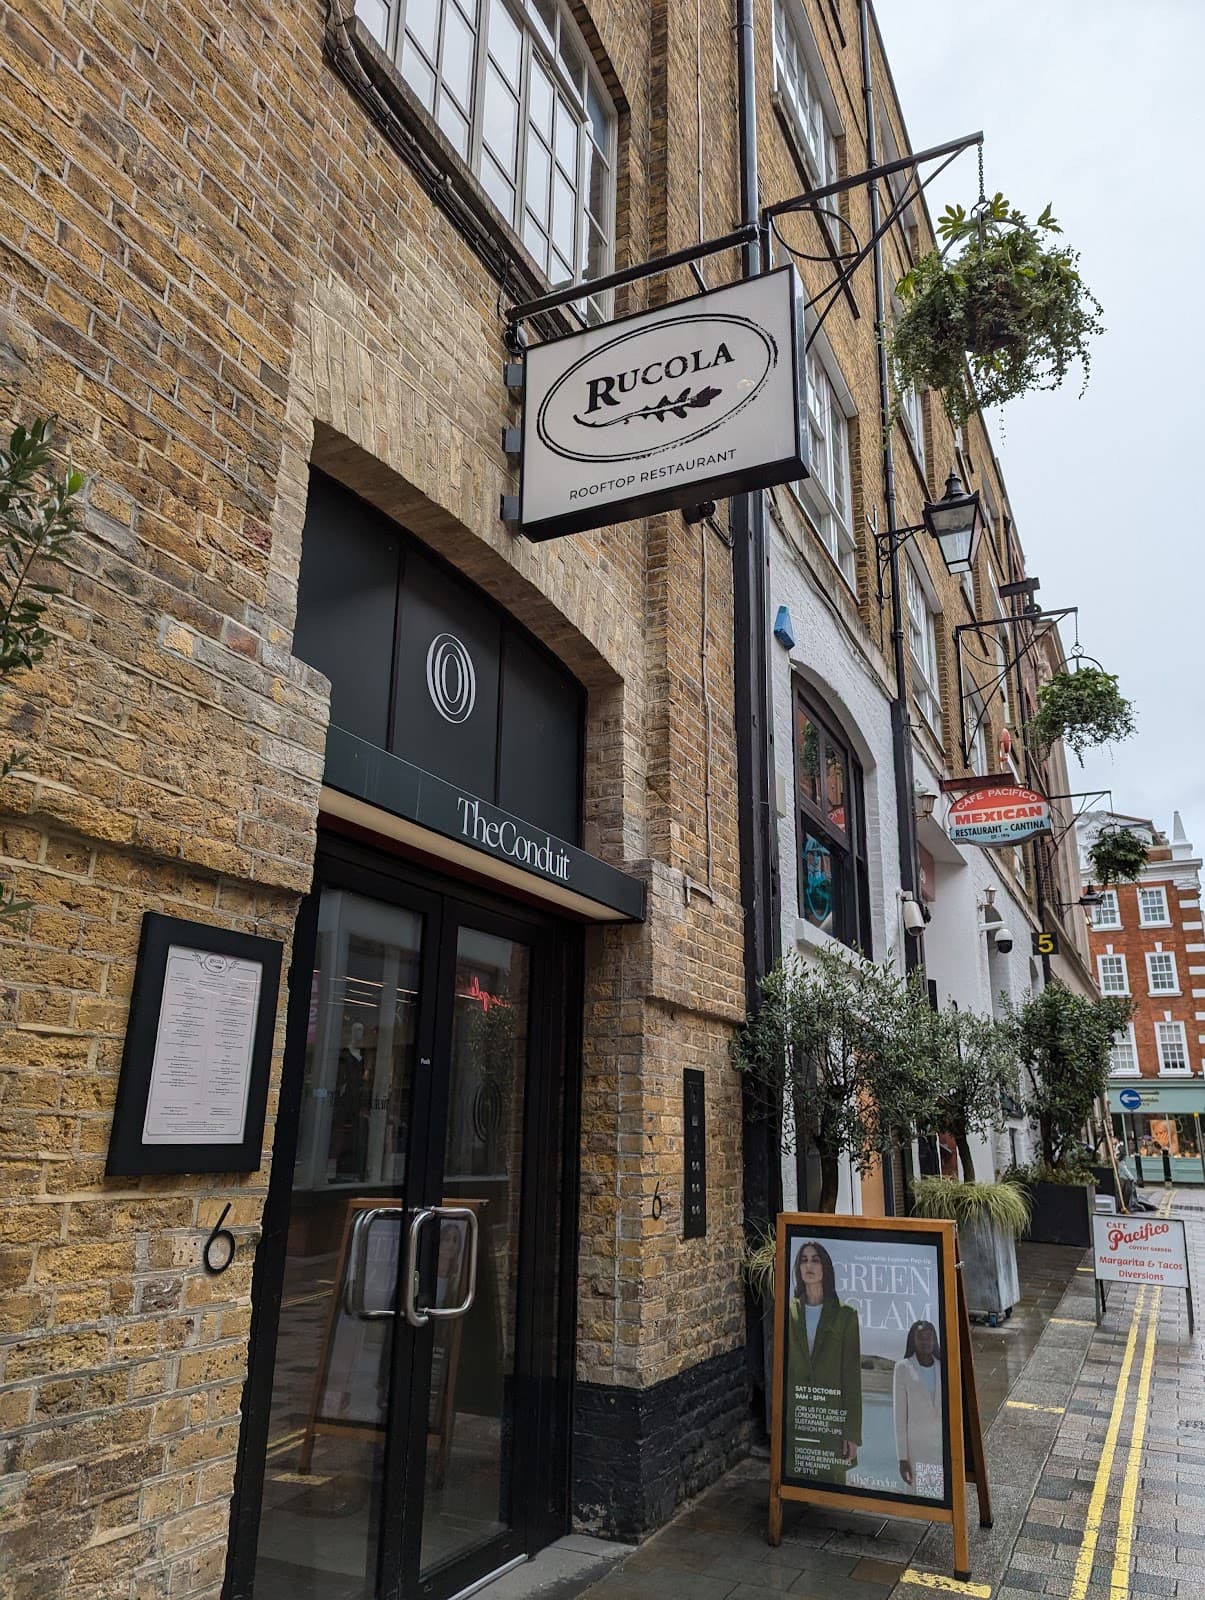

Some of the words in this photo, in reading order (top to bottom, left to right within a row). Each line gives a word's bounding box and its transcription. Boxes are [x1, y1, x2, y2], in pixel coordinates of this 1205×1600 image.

[584, 342, 735, 415] RUCOLA
[569, 475, 635, 500] ROOFTOP
[640, 449, 737, 483] RESTAURANT
[956, 792, 984, 810] CAFE
[987, 788, 1038, 802] PACIFICO
[955, 806, 1043, 826] MEXICAN
[457, 797, 570, 881] TheConduit
[955, 825, 1002, 838] RESTAURANT
[1010, 820, 1045, 831] CANTINA
[1038, 934, 1054, 954] 5
[651, 1180, 662, 1220] 6
[203, 1202, 236, 1275] 6
[1107, 1222, 1170, 1251] Pacifico
[1098, 1256, 1145, 1267] Margarita
[1147, 1260, 1155, 1268] &
[1158, 1261, 1183, 1270] Tacos
[1118, 1269, 1165, 1281] Diversions
[832, 1261, 932, 1297] GREEN
[795, 1385, 807, 1393] SAT
[812, 1387, 841, 1396] OCTOBER
